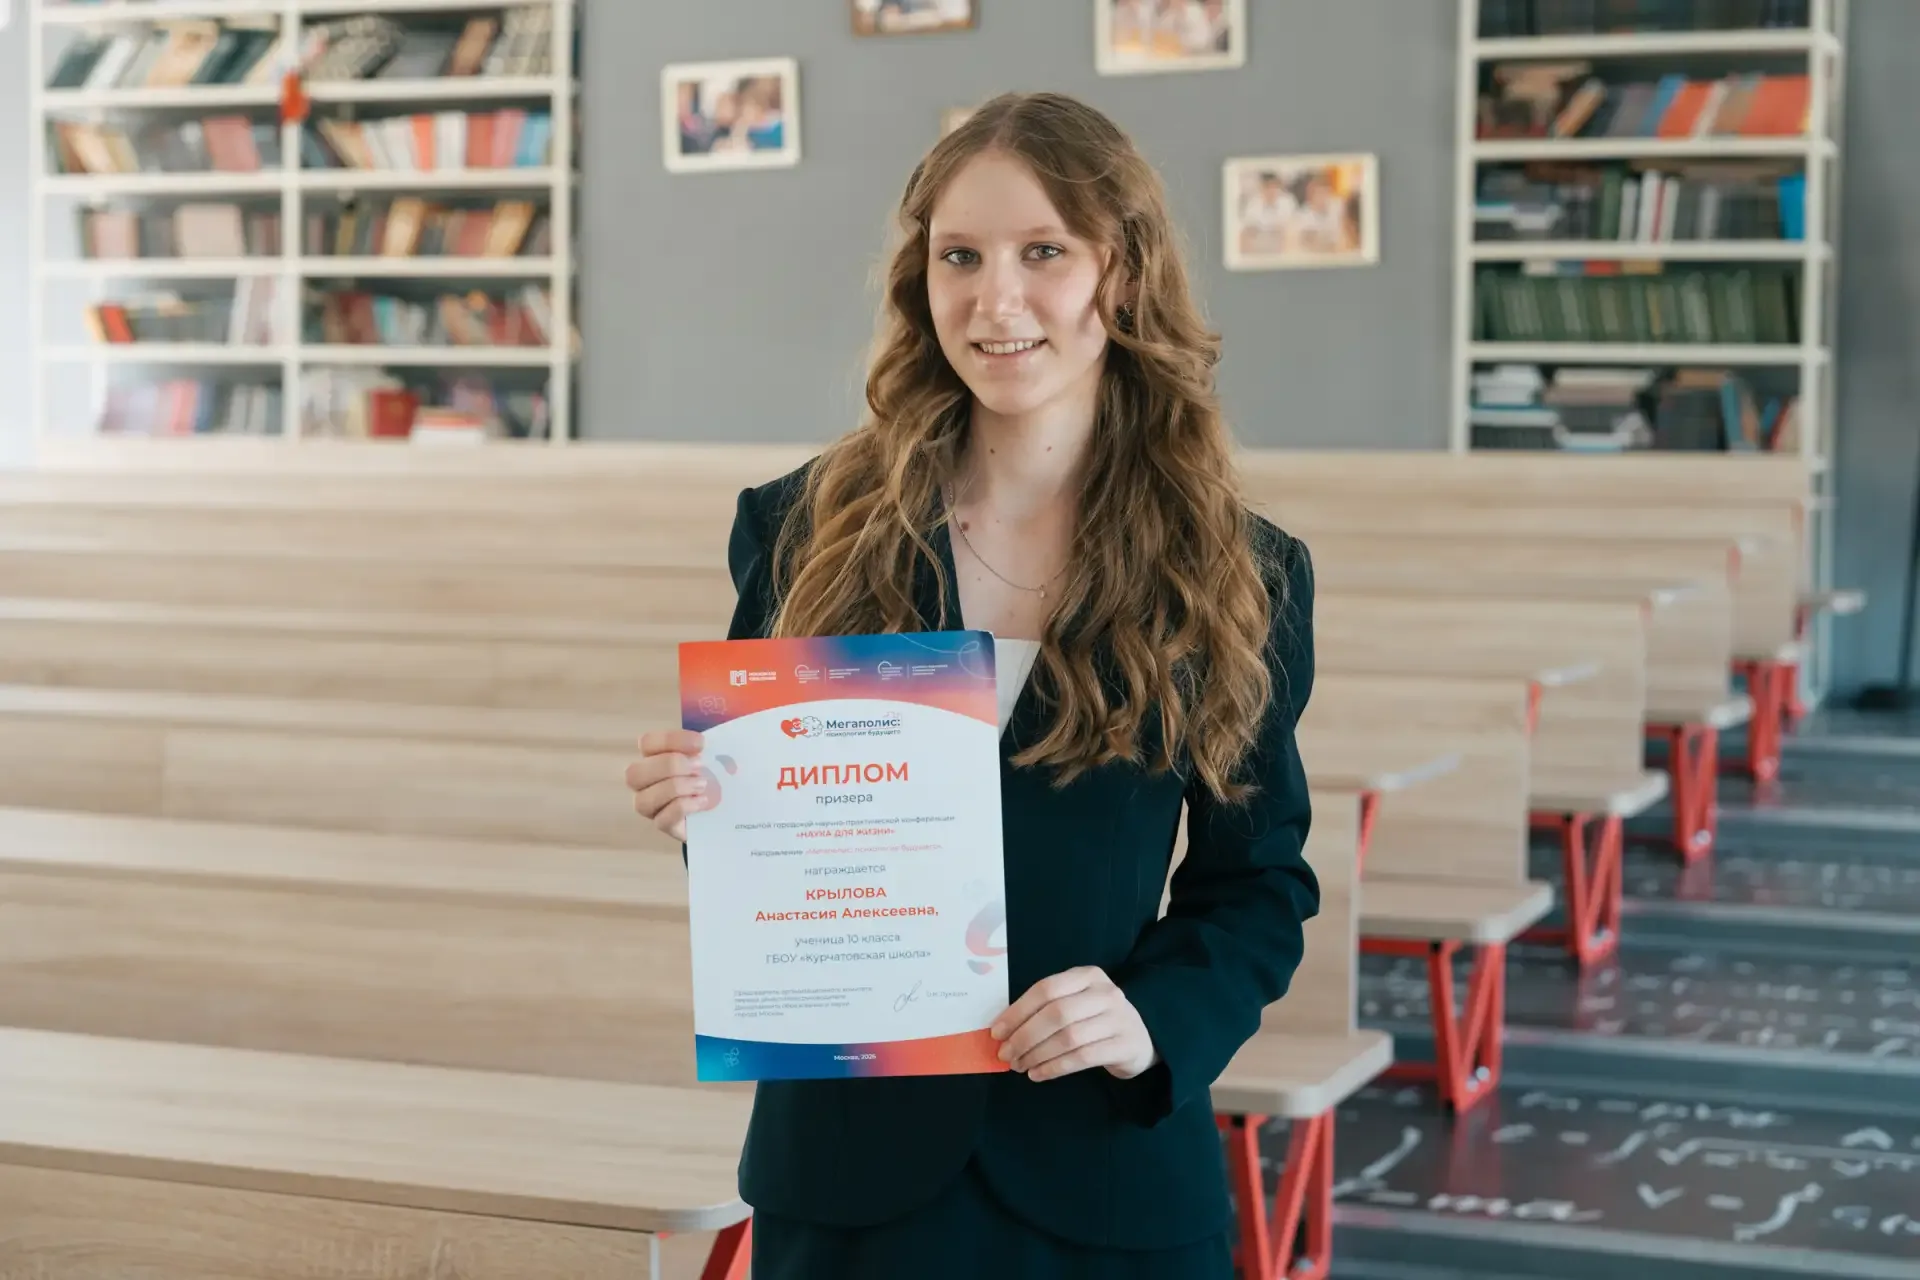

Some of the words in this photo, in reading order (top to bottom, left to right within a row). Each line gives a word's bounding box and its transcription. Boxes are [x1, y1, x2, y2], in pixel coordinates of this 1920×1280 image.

[826, 718, 901, 730] Мегаполис:
[777, 762, 909, 790] ДИПЛОМ
[815, 793, 873, 805] призера
[796, 830, 832, 838] «НАУКА
[834, 829, 853, 837] ДЛЯ
[856, 828, 896, 836] ЖИЗНИ»
[804, 864, 887, 877] награждается
[805, 887, 887, 901] КРЫЛОВА
[755, 909, 837, 922] Анастасия
[842, 906, 939, 919] Алексеевна,
[794, 936, 844, 947] ученица
[847, 934, 858, 944] 10
[861, 933, 901, 943] класса
[765, 953, 796, 964] ГБОУ
[799, 951, 886, 964] «Курчатовская
[888, 950, 932, 960] школа»
